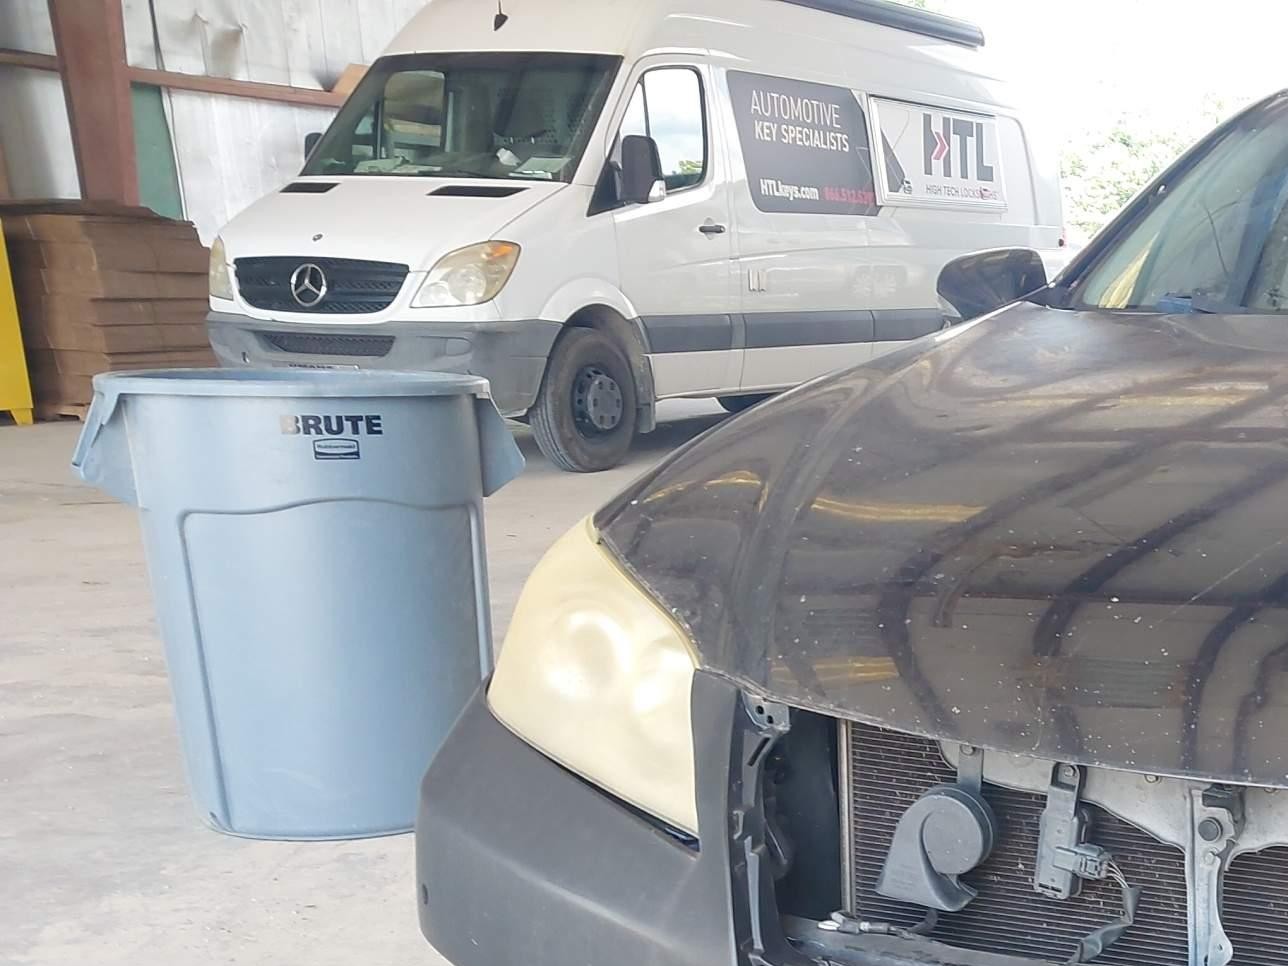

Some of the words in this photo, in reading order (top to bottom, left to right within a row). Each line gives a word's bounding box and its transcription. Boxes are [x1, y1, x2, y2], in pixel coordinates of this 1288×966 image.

[751, 89, 841, 128] AUTOMOTIVE
[755, 120, 777, 142] KEY
[781, 124, 849, 152] SPECIALISTS
[922, 112, 994, 183] HTL
[760, 178, 819, 201] HTLkeys.com
[943, 185, 960, 198] TECH
[280, 414, 383, 436] BRUTE
